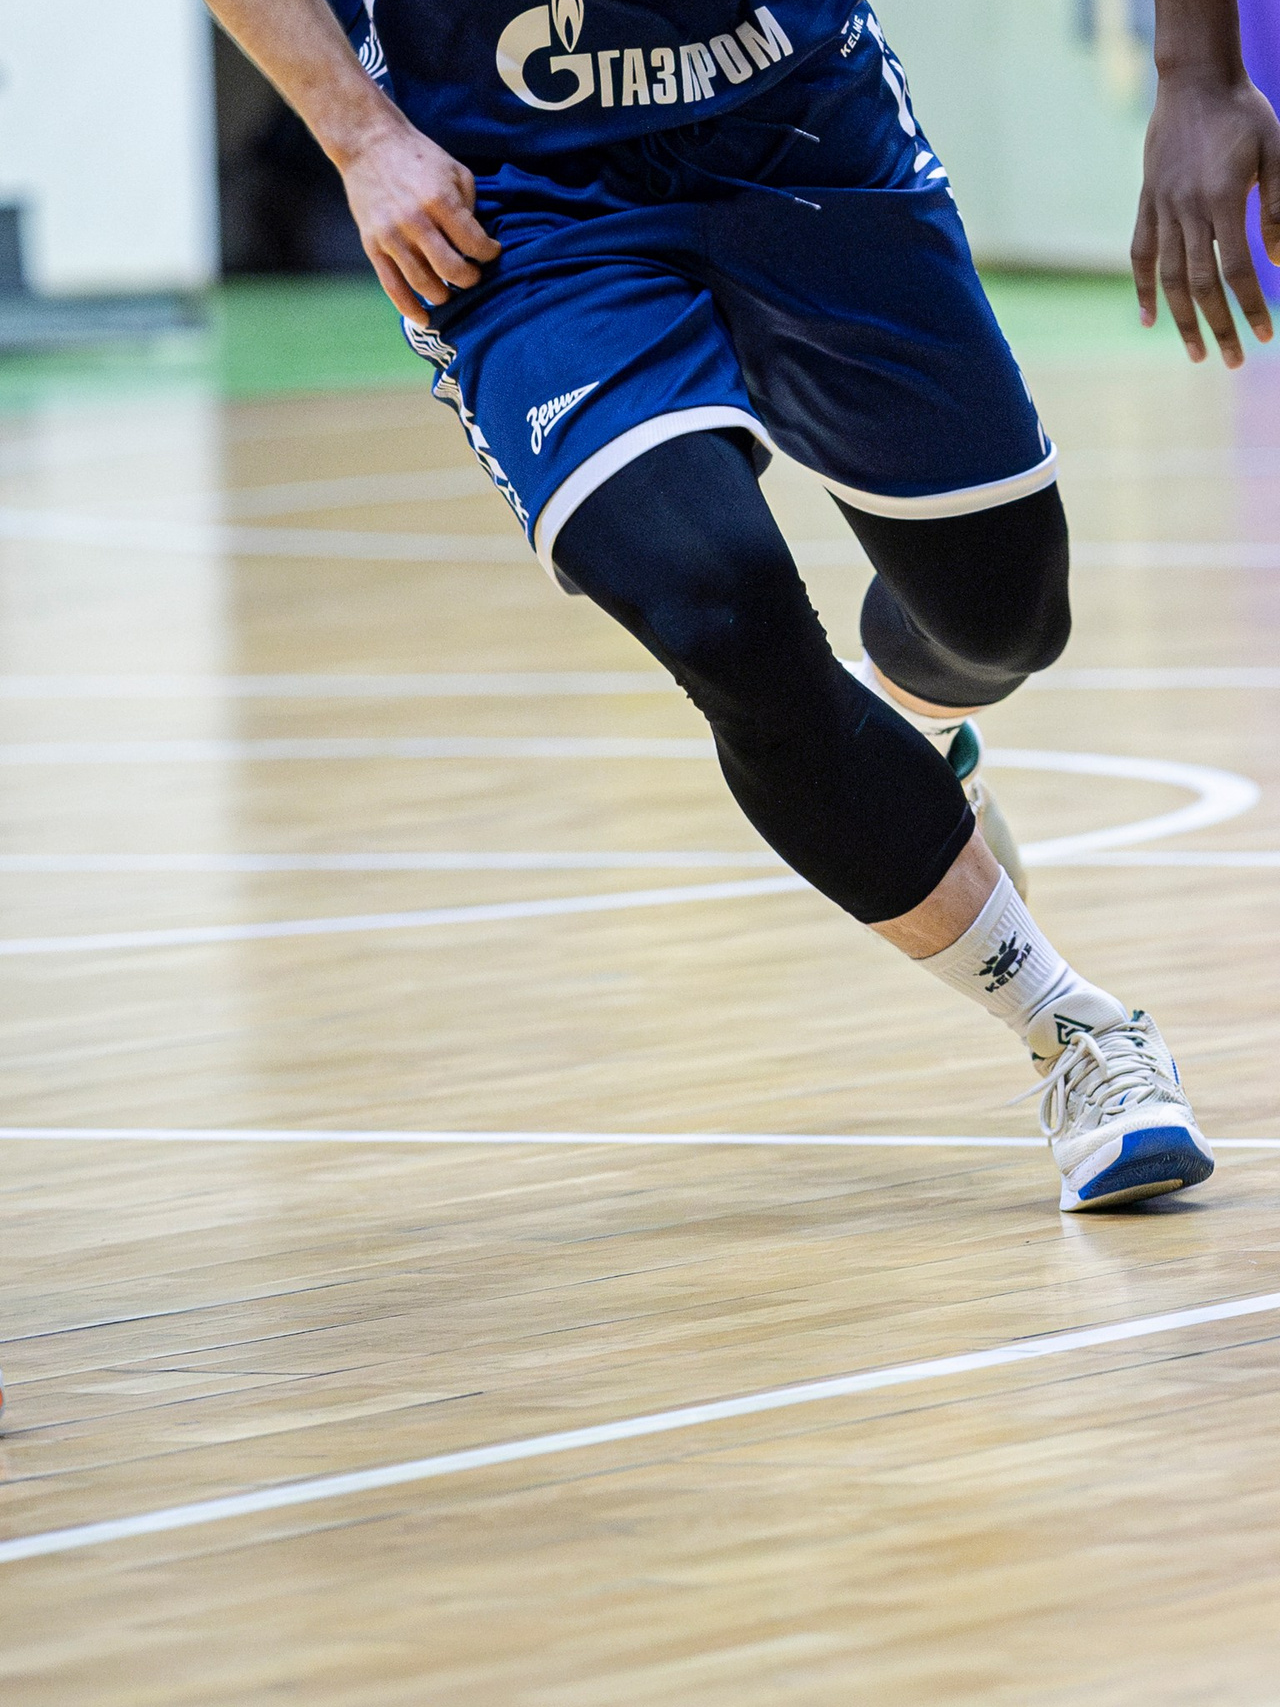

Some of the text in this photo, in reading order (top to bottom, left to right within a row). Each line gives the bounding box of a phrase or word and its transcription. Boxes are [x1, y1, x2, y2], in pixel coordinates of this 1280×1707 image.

[597, 5, 794, 108] ГАЗПРОМ
[840, 14, 864, 58] KELME
[984, 942, 1032, 993] KELME
